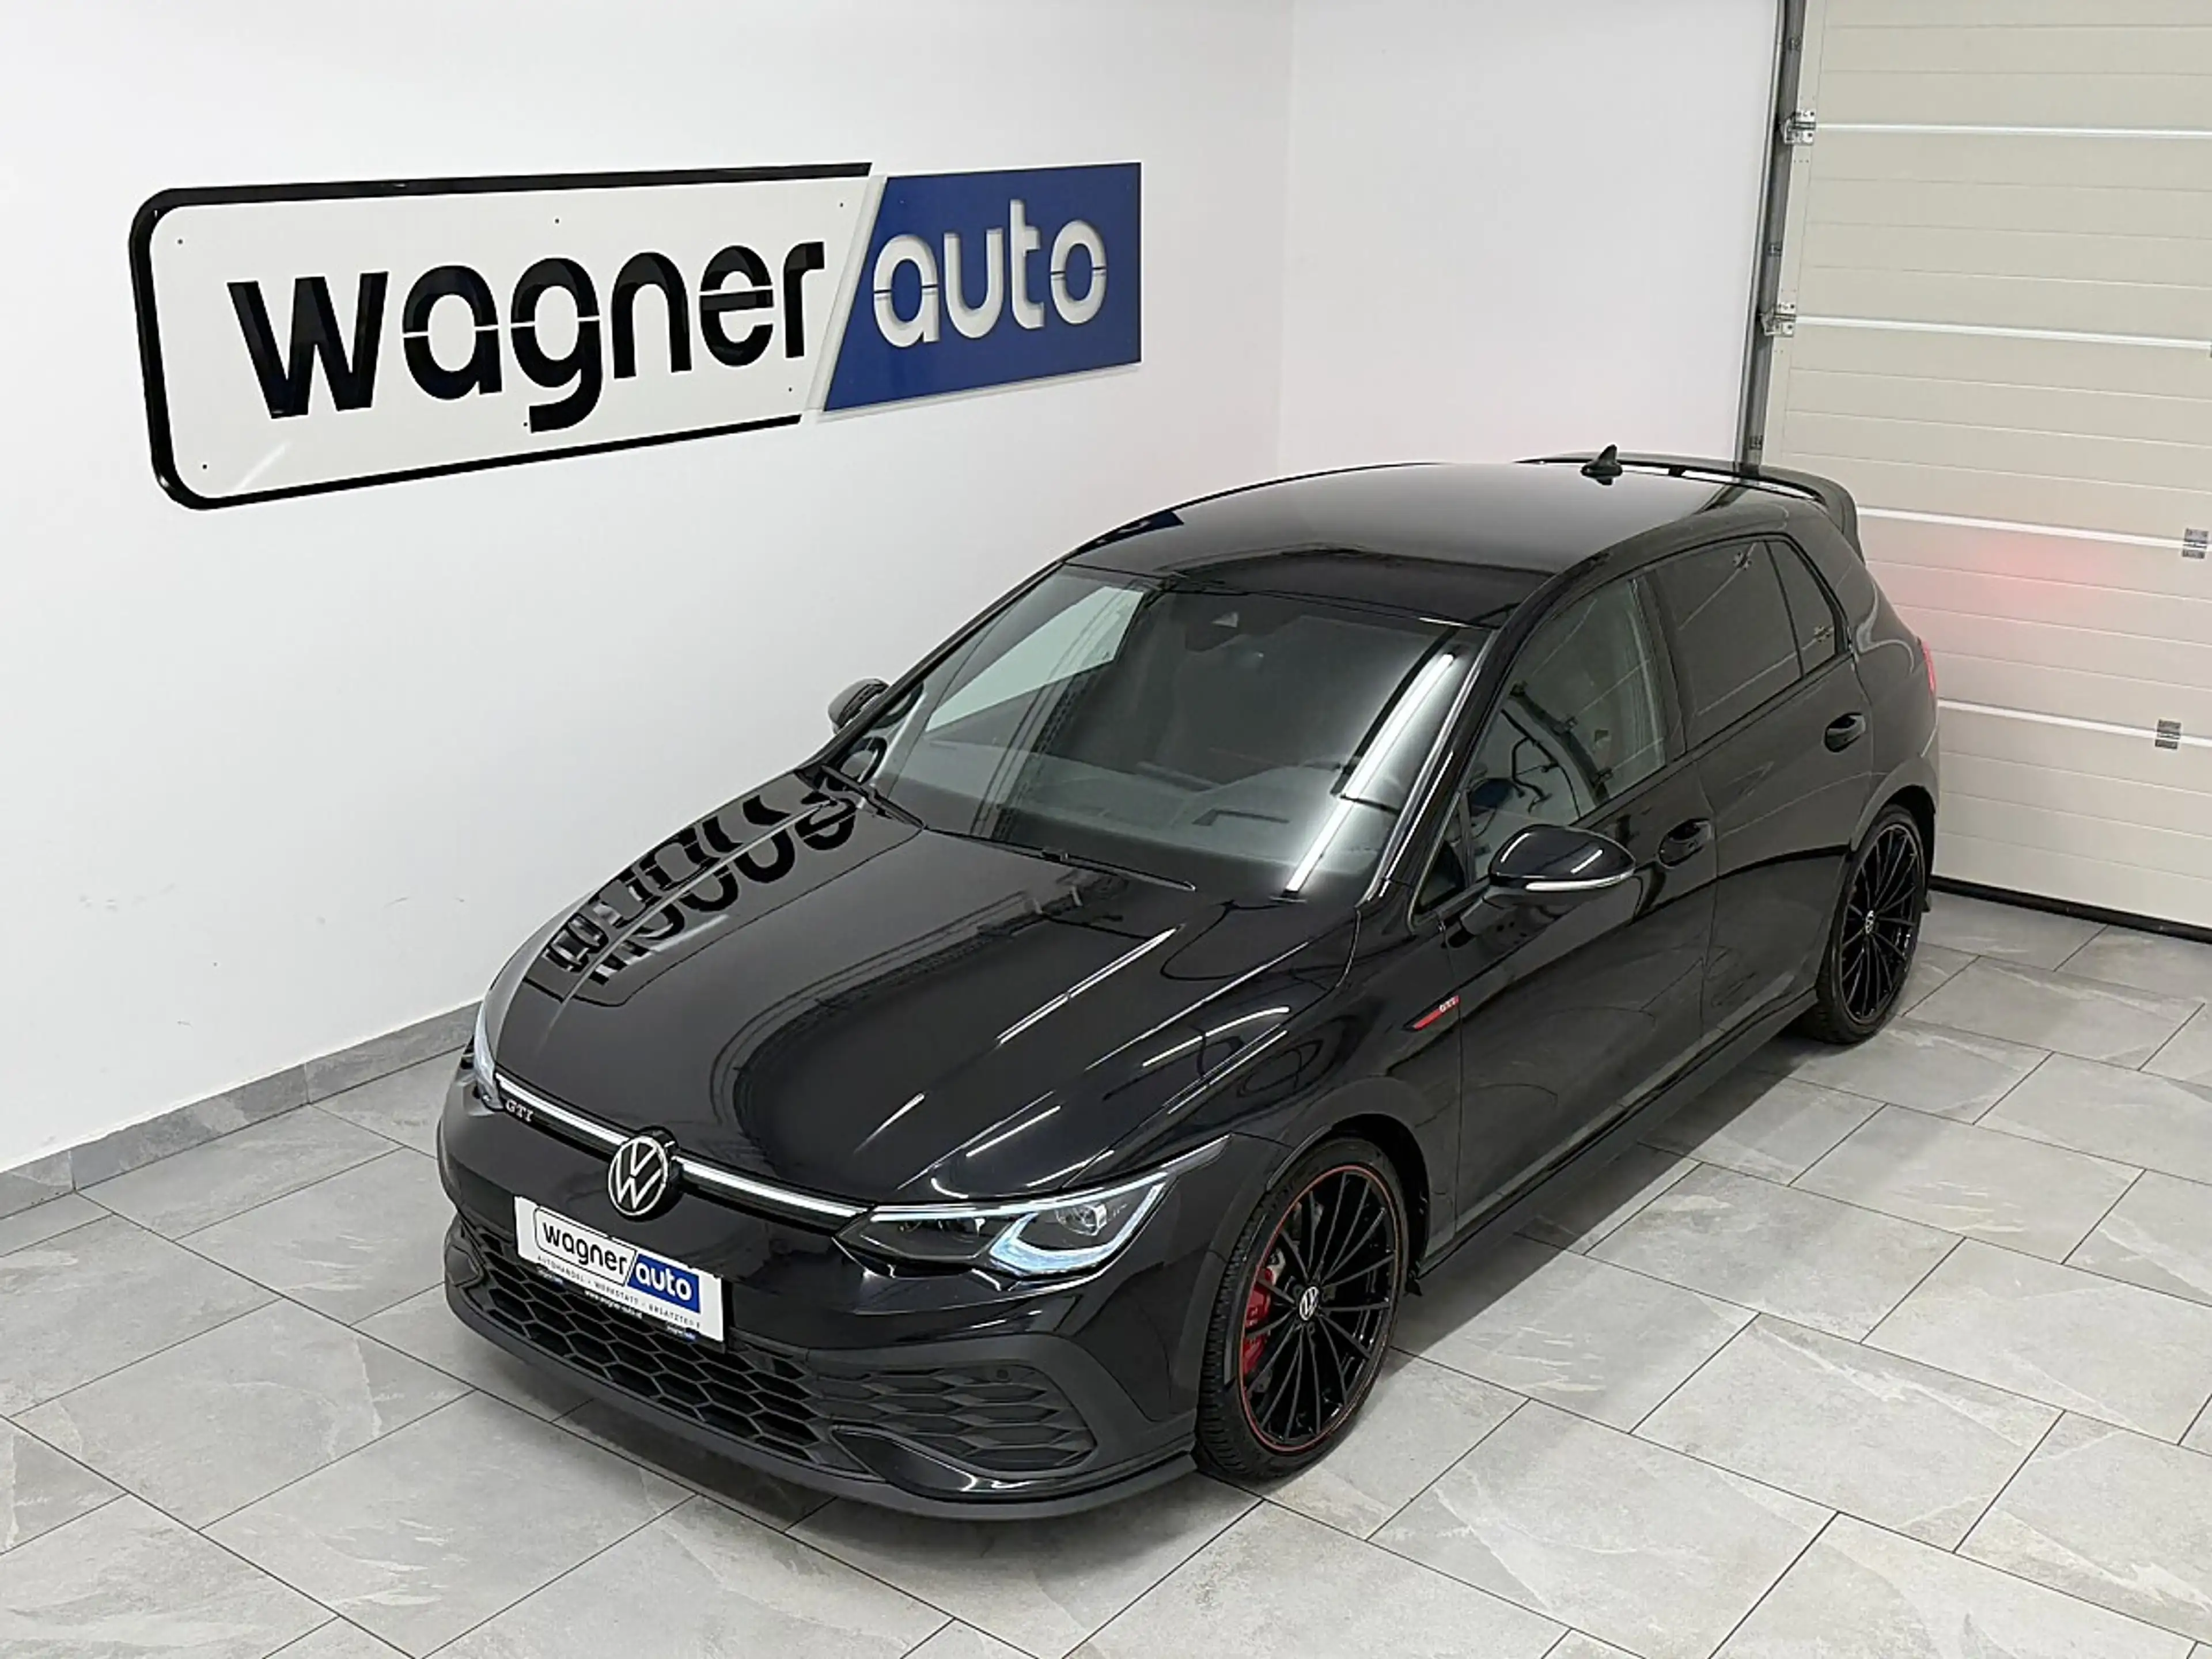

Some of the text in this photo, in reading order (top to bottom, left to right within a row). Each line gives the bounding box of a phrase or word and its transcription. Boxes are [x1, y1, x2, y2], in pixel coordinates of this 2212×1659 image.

[227, 199, 1106, 433] wagner auto
[505, 1099, 533, 1122] GTI
[543, 1222, 692, 1301] wagner auto
